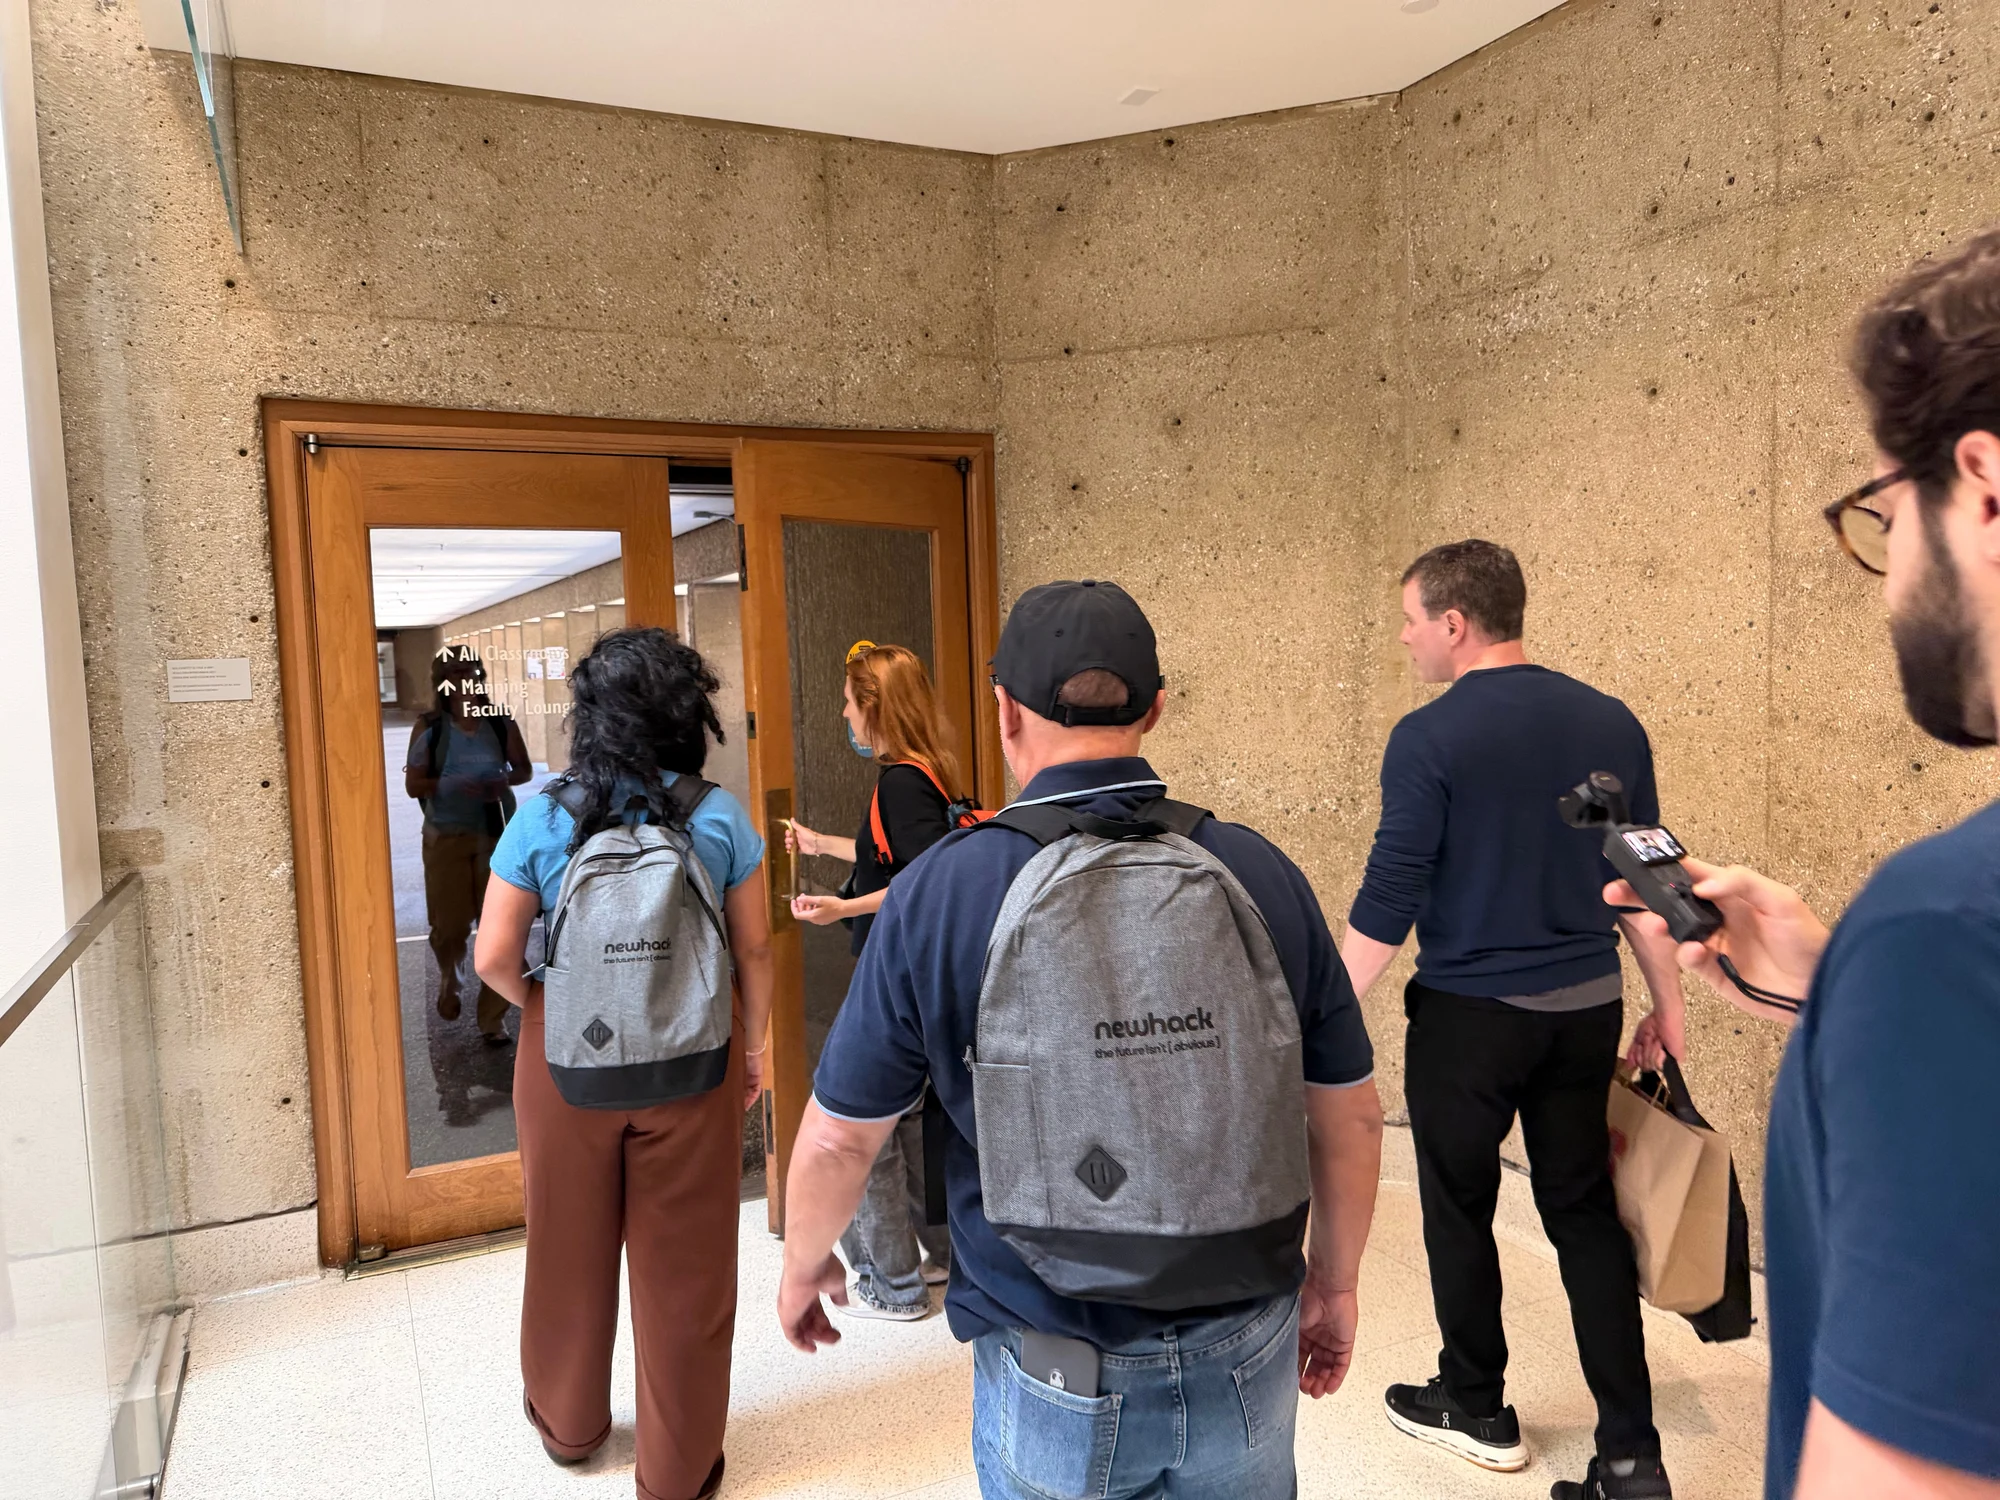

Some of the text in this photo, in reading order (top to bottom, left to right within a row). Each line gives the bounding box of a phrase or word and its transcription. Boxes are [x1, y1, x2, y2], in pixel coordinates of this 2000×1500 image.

[460, 645, 479, 661] All
[461, 679, 528, 697] Manning
[463, 701, 518, 720] Faculty
[1094, 1007, 1214, 1040] newhack
[1095, 1048, 1114, 1059] the
[1115, 1046, 1145, 1057] future
[1145, 1042, 1167, 1054] isn't
